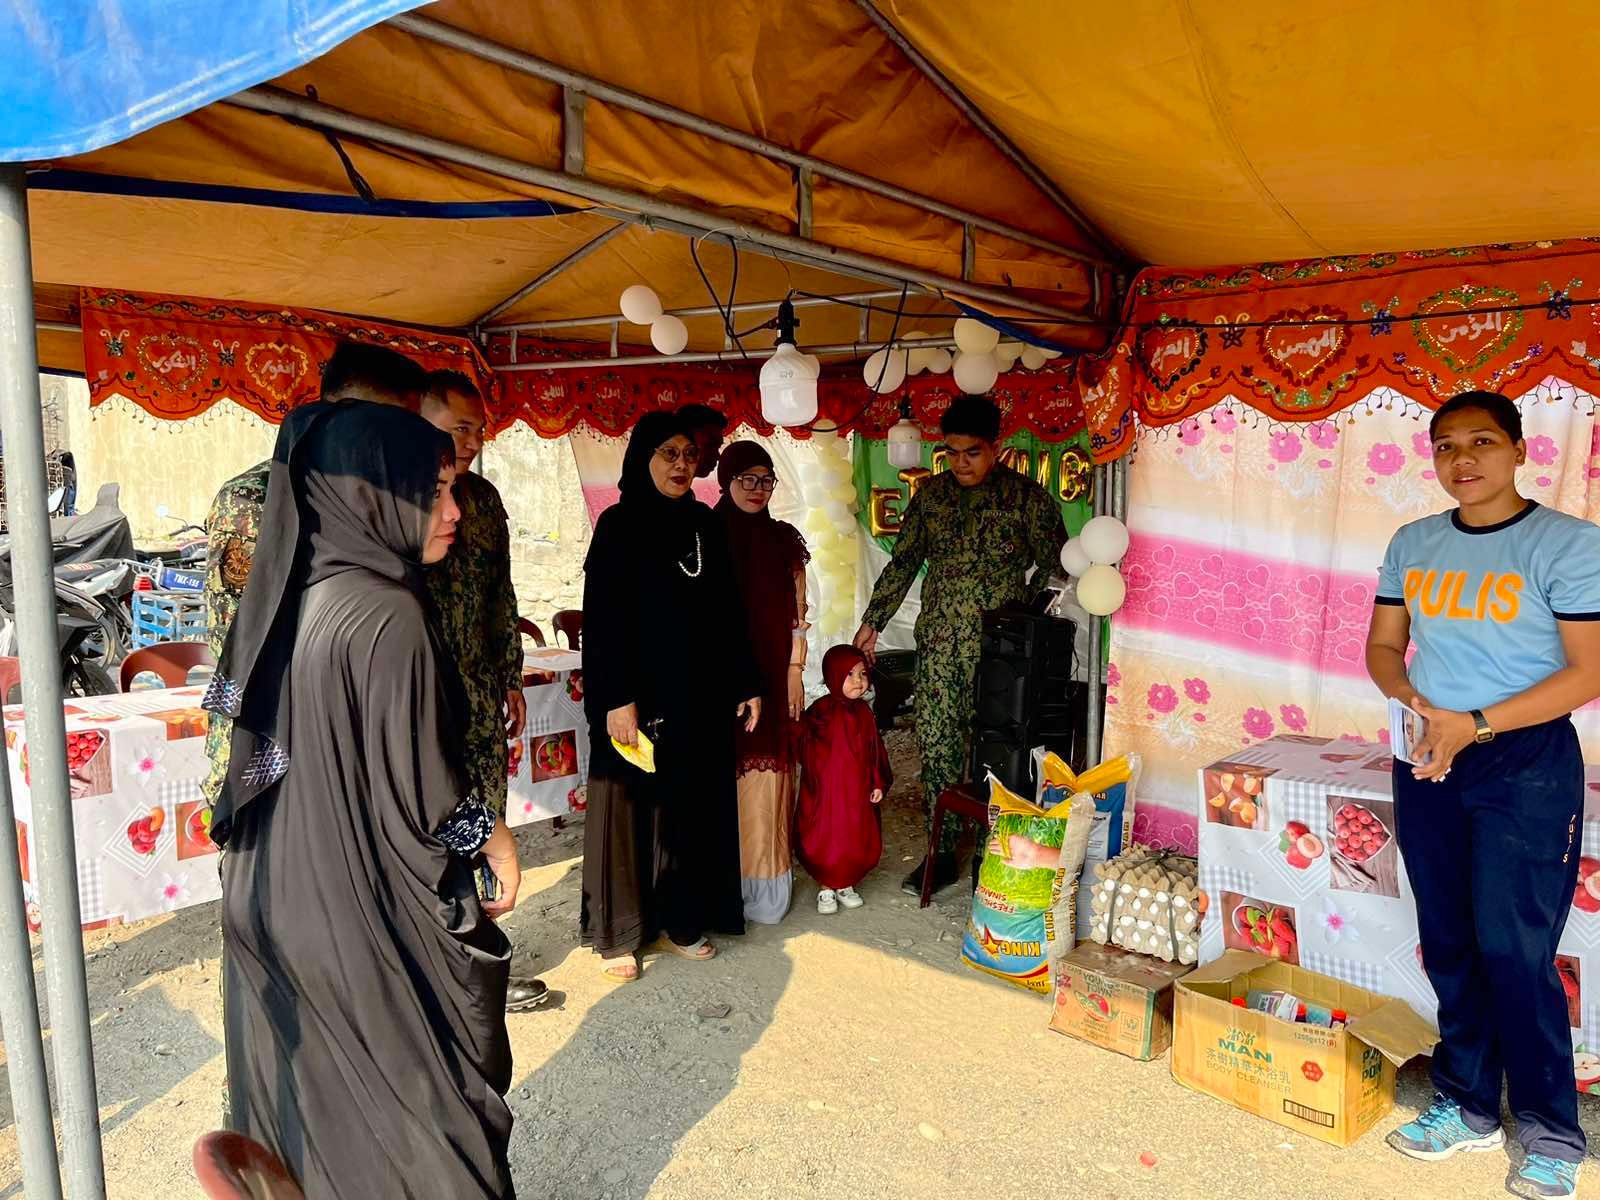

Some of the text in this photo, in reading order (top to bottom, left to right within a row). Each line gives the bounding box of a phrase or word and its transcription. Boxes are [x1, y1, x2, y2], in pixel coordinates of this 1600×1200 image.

[1404, 568, 1524, 623] PULIS
[1000, 941, 1041, 958] KING
[1217, 1037, 1273, 1064] MAN
